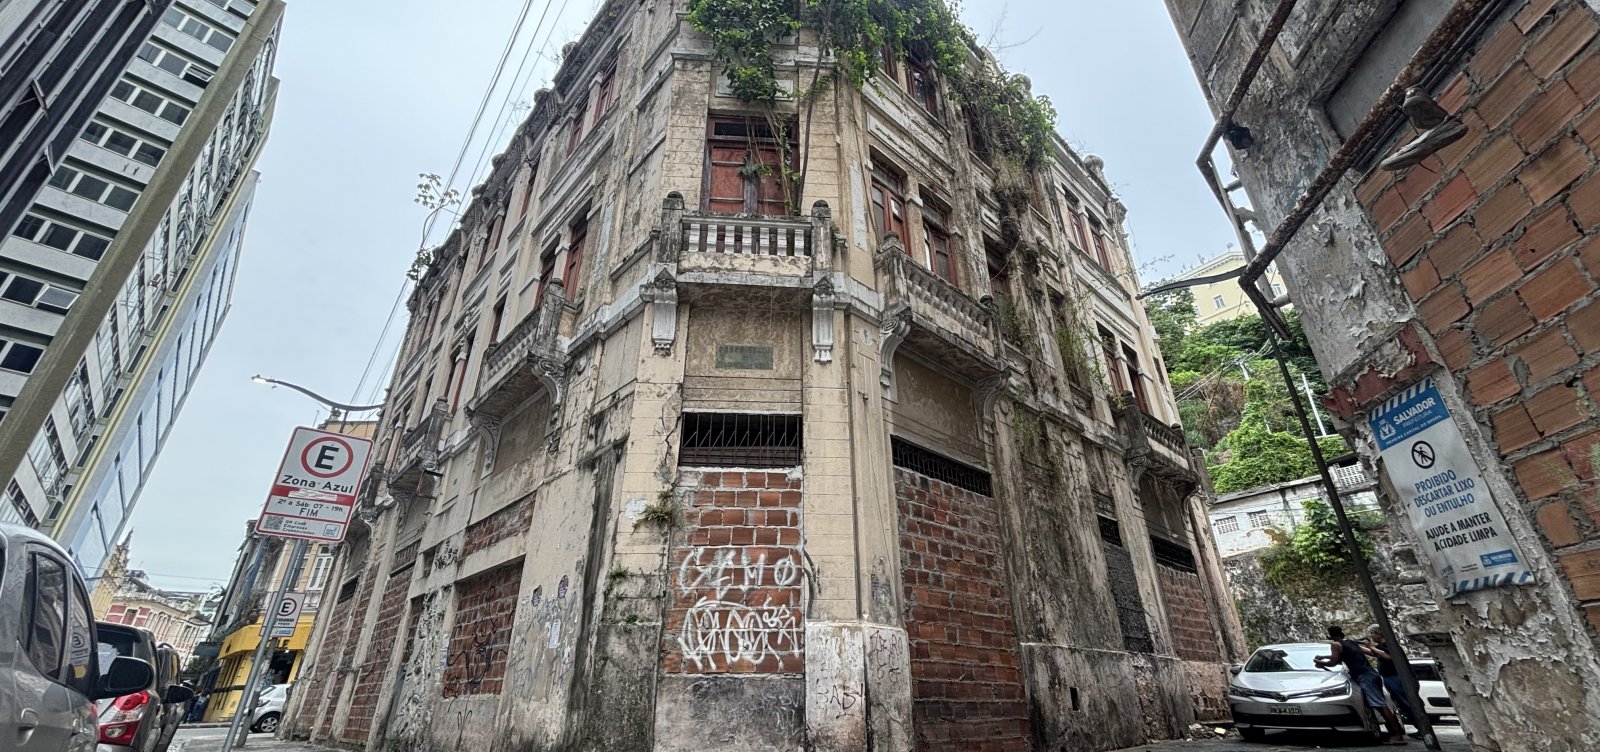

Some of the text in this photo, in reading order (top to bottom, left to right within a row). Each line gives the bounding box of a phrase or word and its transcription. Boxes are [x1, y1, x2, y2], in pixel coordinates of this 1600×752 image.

[1393, 397, 1436, 425] SALVADOR
[1402, 410, 1433, 428] PREFEITURA
[314, 445, 340, 471] E
[281, 475, 354, 494] Zona Azul
[1414, 469, 1457, 493] PROIBIDO
[1414, 477, 1475, 508] DESCARTAR LIXO
[299, 508, 319, 517] FIM
[1424, 493, 1475, 518] OU ENTULHO
[1425, 511, 1493, 540] AJUDE A MANTER
[1469, 526, 1498, 542] LIMPA
[280, 602, 291, 613] E
